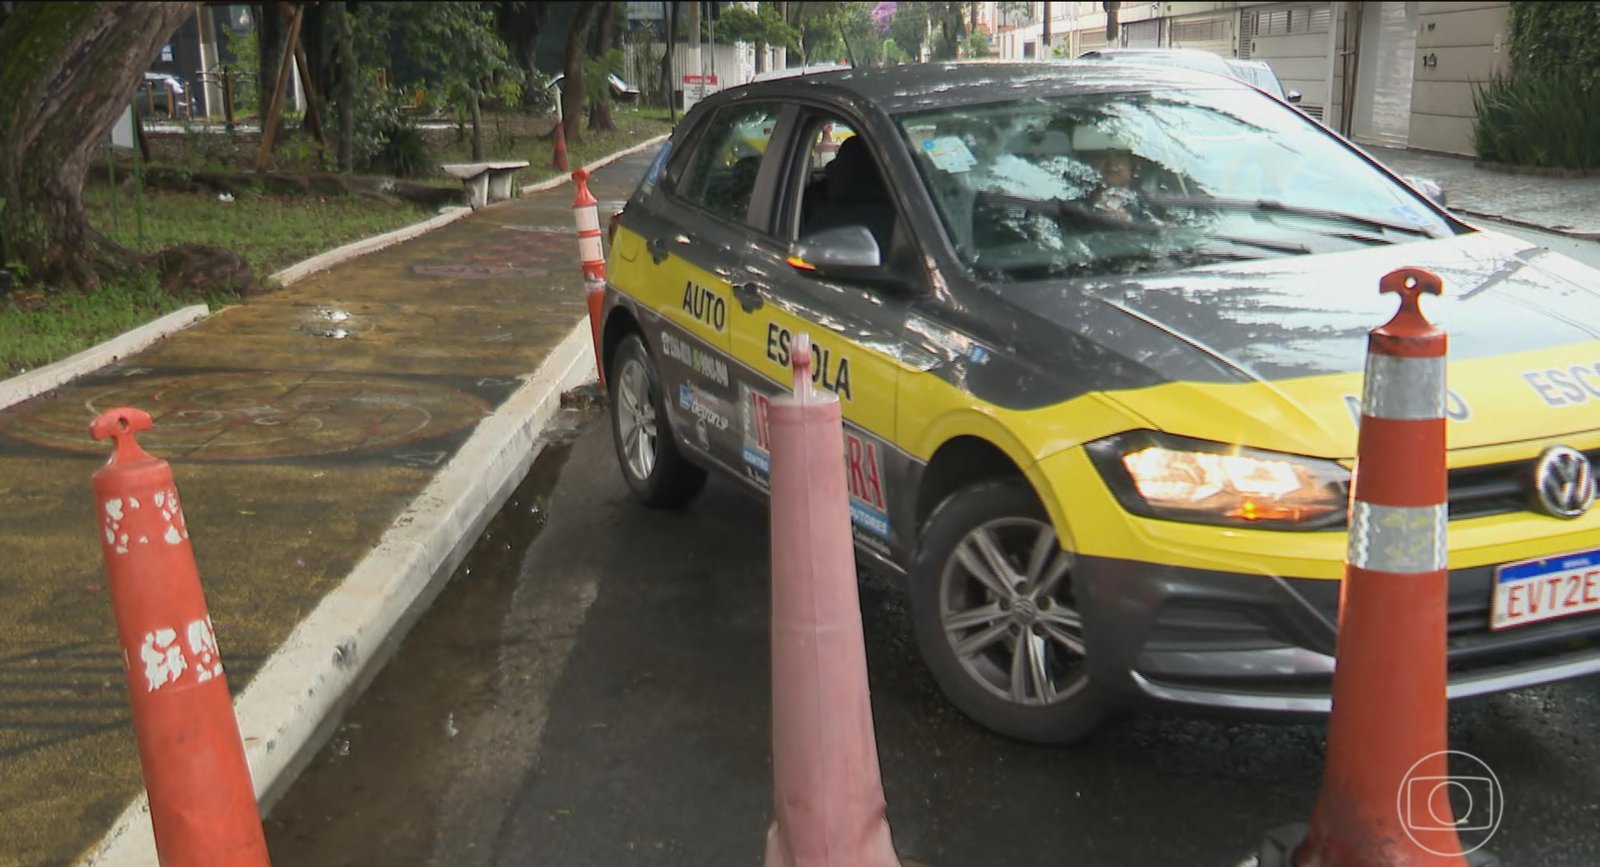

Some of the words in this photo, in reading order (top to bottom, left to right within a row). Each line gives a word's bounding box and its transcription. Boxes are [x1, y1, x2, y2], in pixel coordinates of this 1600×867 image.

[682, 280, 726, 332] AUTO
[767, 322, 852, 401] ESOLA
[1522, 361, 1600, 406] ESC
